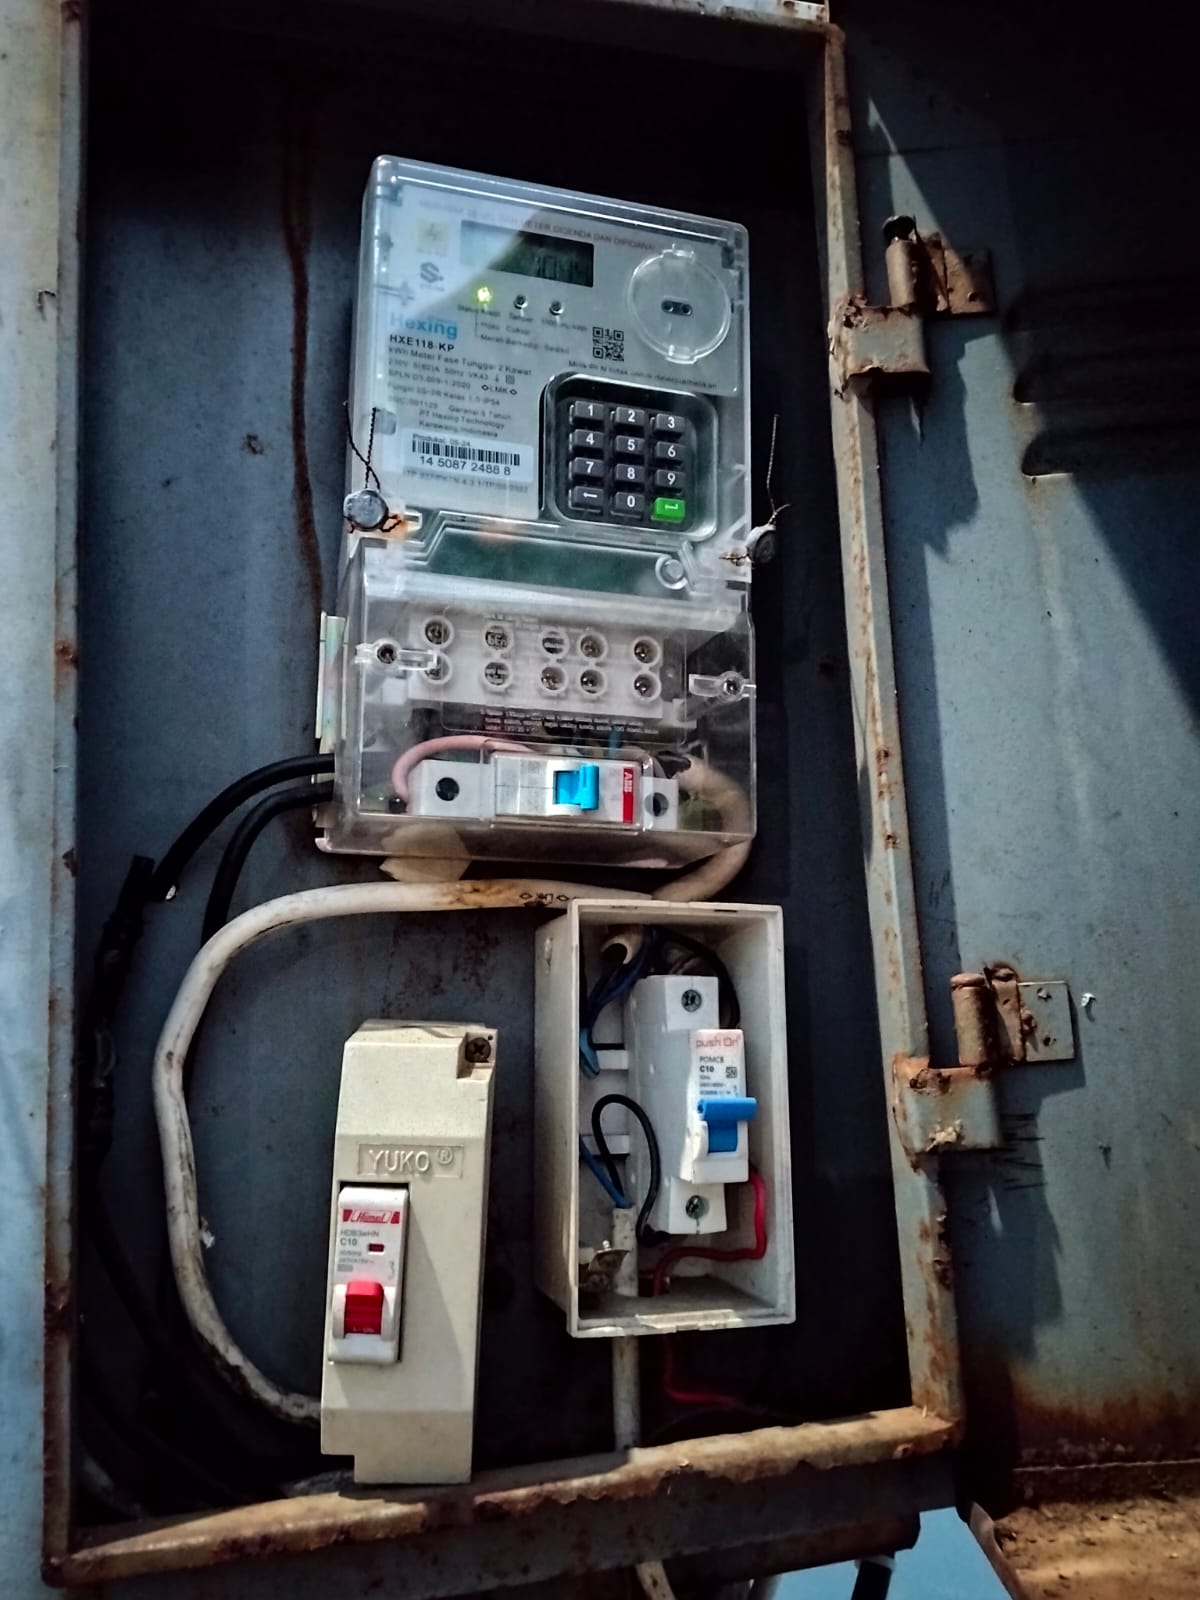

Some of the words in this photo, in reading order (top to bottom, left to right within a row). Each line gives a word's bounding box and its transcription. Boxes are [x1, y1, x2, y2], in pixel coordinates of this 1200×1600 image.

[391, 312, 458, 340] Hexing
[410, 350, 435, 361] Meter
[505, 364, 532, 376] Kawat
[588, 404, 593, 417] 1
[627, 410, 635, 422] 2
[432, 412, 459, 424] Hexing
[461, 415, 504, 430] Technology
[667, 416, 675, 429] 3
[586, 433, 594, 446] 4
[627, 439, 635, 451] 5
[667, 445, 676, 458] 6
[419, 456, 434, 466] 14
[437, 458, 467, 470] 5087
[471, 463, 500, 475] 2488
[503, 466, 512, 476] 8
[586, 461, 594, 474] 7
[627, 467, 635, 480] 8
[667, 473, 676, 486] 9
[627, 495, 635, 508] 0
[623, 772, 633, 793] ABB
[700, 1065, 715, 1073] C10
[368, 1149, 430, 1173] YUKO
[340, 1238, 358, 1247] C10
